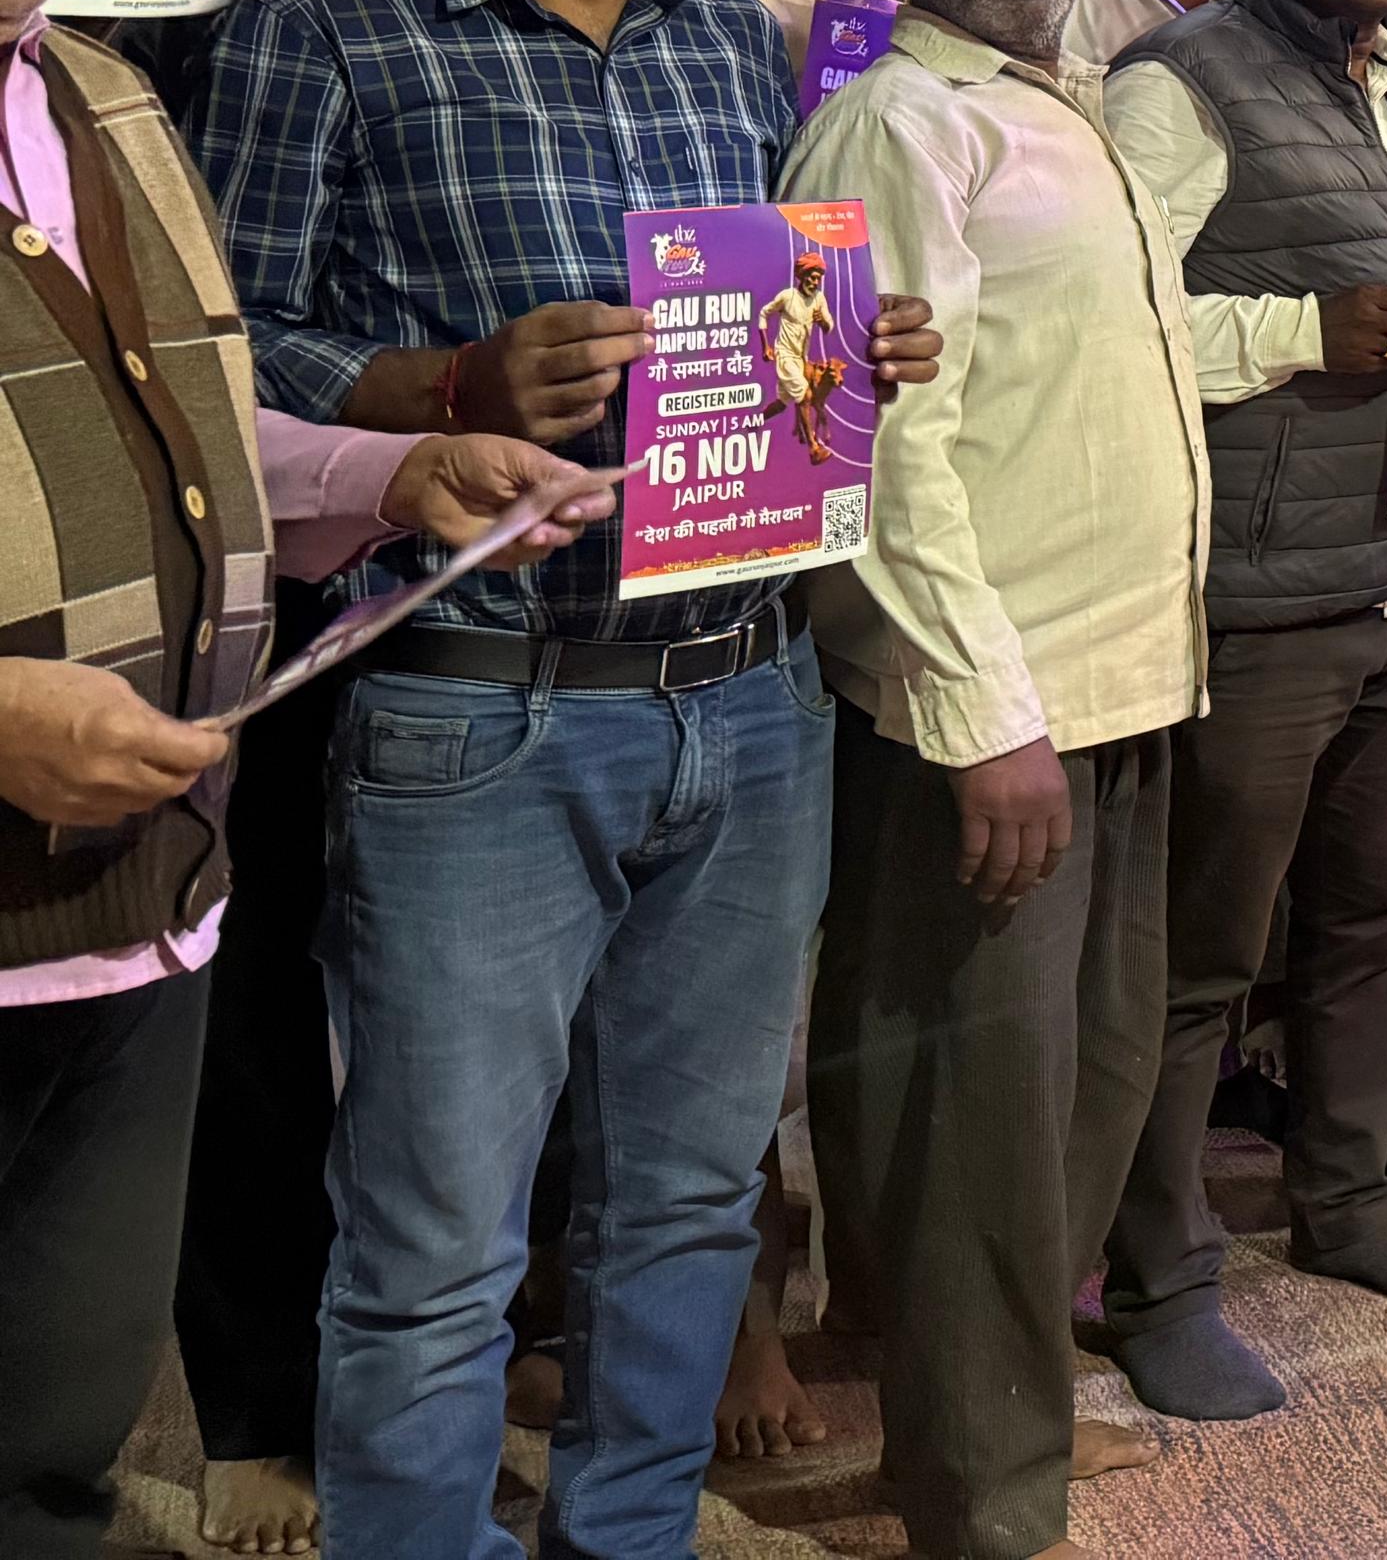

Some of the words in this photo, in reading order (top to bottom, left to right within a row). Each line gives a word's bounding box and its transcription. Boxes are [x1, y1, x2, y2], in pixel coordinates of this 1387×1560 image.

[653, 297, 699, 330] GAU
[705, 292, 751, 324] RUN
[655, 331, 708, 355] JAIPUR
[709, 326, 748, 349] 2025
[648, 358, 668, 384] गौ
[672, 357, 723, 382] सम्मान
[727, 349, 754, 379] दौड़
[665, 392, 725, 412] REGISTER
[728, 387, 755, 406] NOW
[656, 418, 720, 440] SUNDAY
[731, 417, 739, 432] 5
[742, 413, 765, 430] AM
[644, 441, 686, 486] 16
[699, 430, 771, 480] NOV
[673, 480, 745, 512] JAIPUR
[673, 518, 694, 540] की
[698, 513, 737, 537] पहली
[740, 508, 756, 530] गौ
